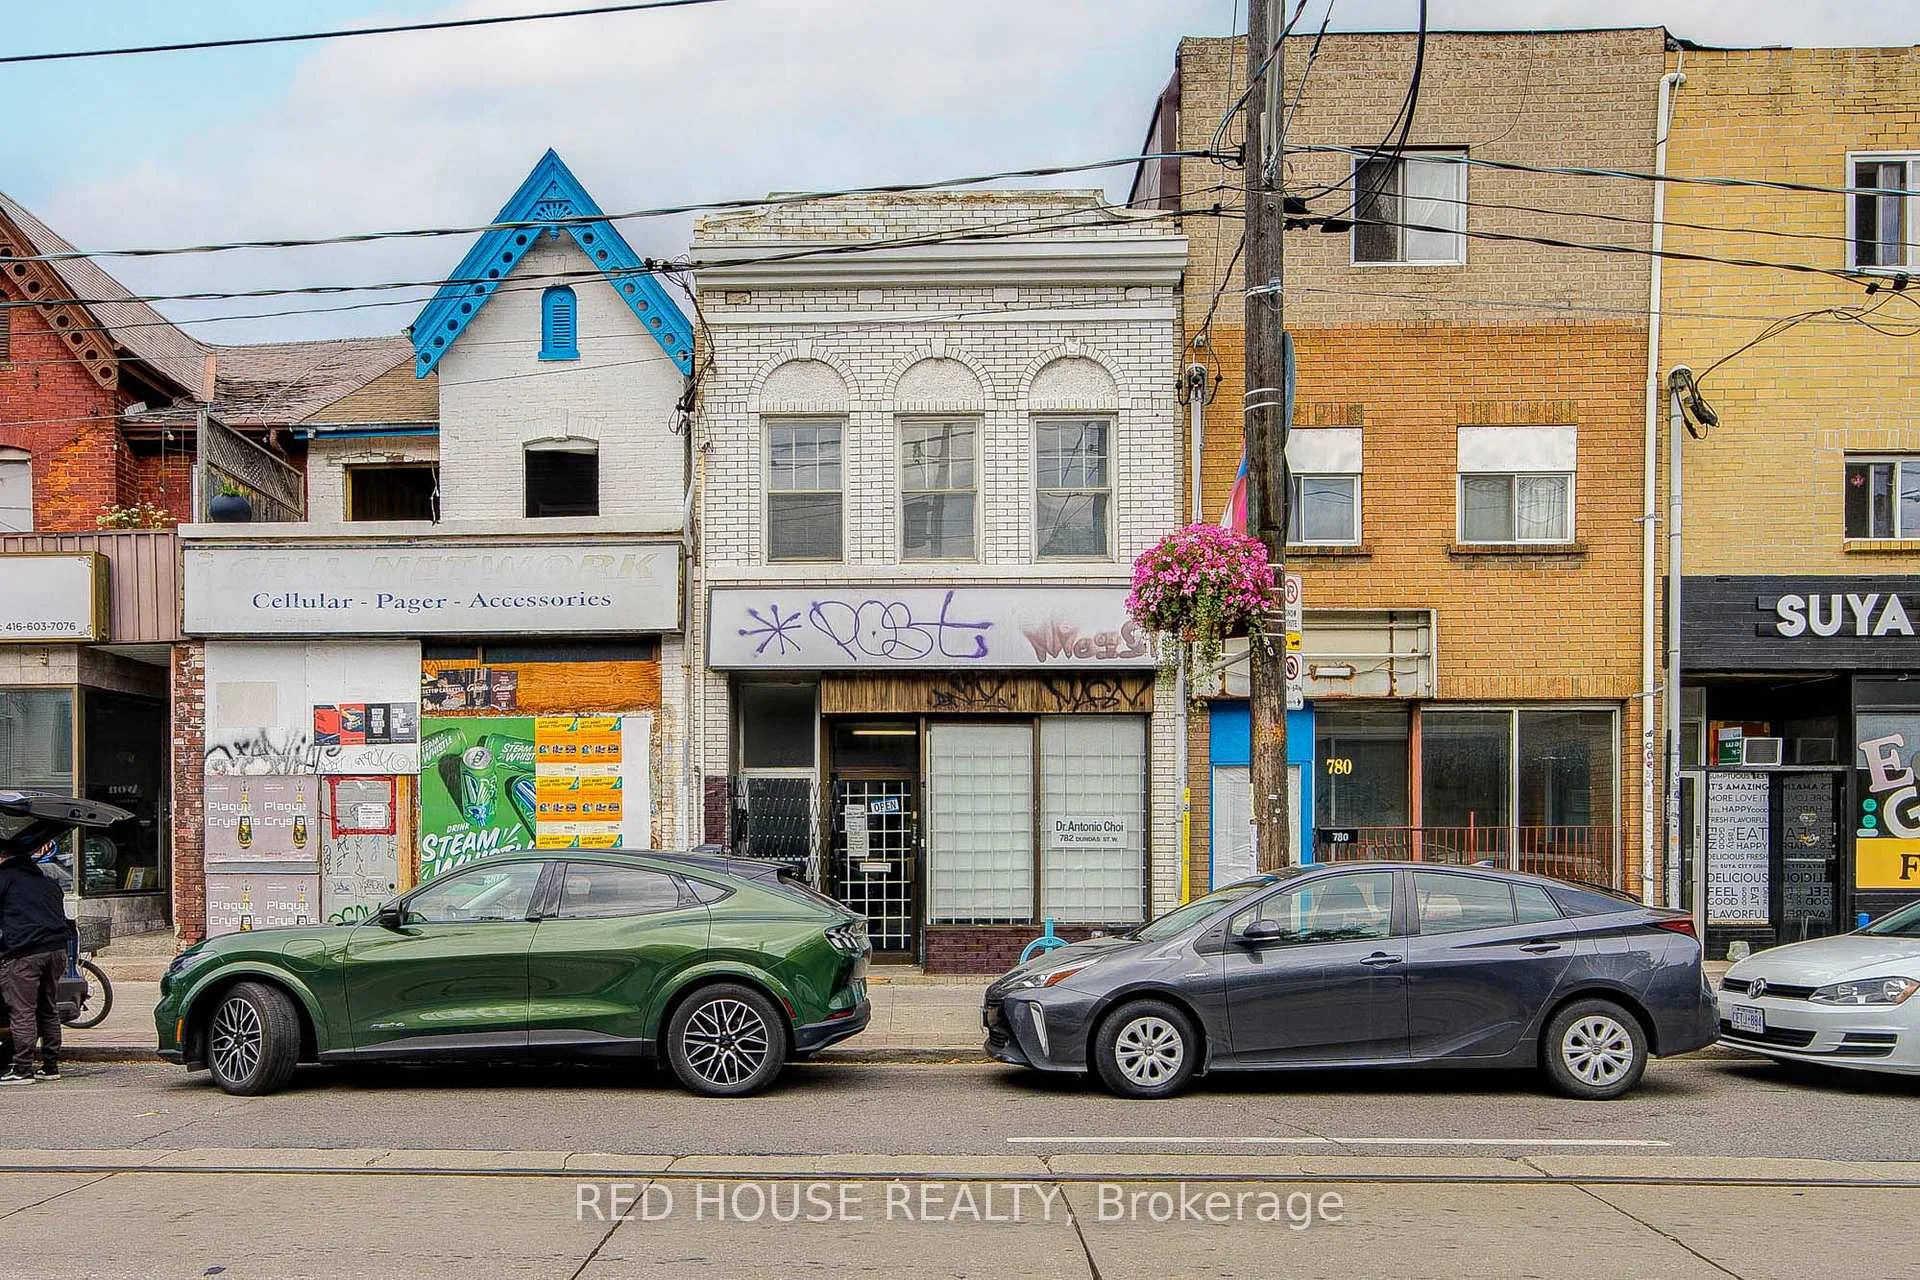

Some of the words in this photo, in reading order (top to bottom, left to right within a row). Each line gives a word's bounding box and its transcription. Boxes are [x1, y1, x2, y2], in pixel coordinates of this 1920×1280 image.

[252, 592, 353, 609] Cellular
[376, 593, 447, 613] Pager
[469, 591, 612, 608] Accessories
[1775, 593, 1915, 637] SUYA
[5, 621, 77, 631] 416-603-7076
[421, 735, 444, 751] TEAM
[502, 743, 534, 753] STEAM
[1326, 758, 1353, 775] 780
[1726, 783, 1769, 791] AMAZING
[1735, 794, 1758, 802] LOVE
[873, 800, 897, 813] OPEN
[1721, 805, 1752, 813] HAPPY
[446, 823, 470, 834] DRINK
[1103, 820, 1125, 832] Choi
[1059, 834, 1074, 842] 782
[1331, 832, 1349, 842] 780
[1736, 826, 1768, 841] EAT
[421, 826, 501, 862] STEAM
[1736, 842, 1768, 850] HAPPY
[1708, 872, 1768, 883] DELICIOUS
[1750, 886, 1760, 905] EAT
[1708, 909, 1768, 919] FLAVORFUL
